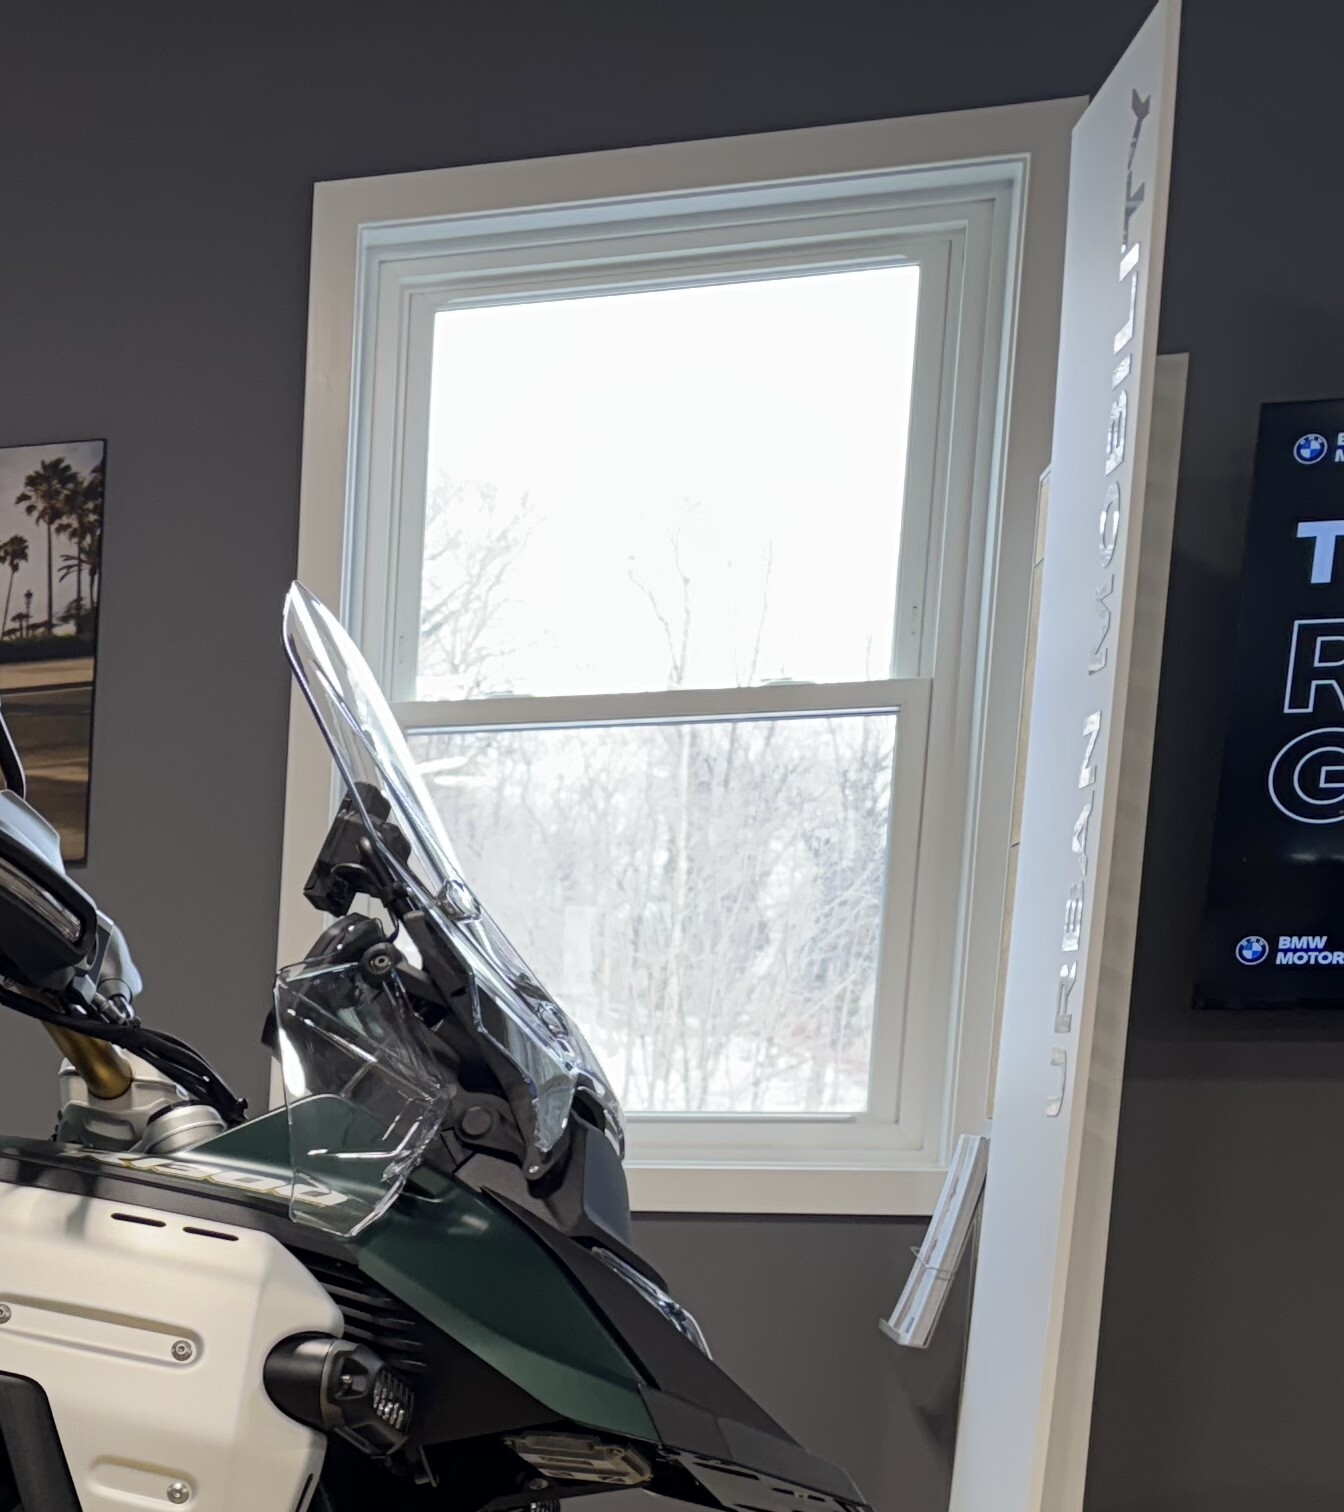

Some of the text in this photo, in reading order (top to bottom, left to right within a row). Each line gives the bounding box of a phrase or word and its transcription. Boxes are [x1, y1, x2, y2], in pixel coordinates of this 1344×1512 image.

[1046, 88, 1151, 1117] URBAN MOBILITY
[1278, 936, 1328, 949] BMW
